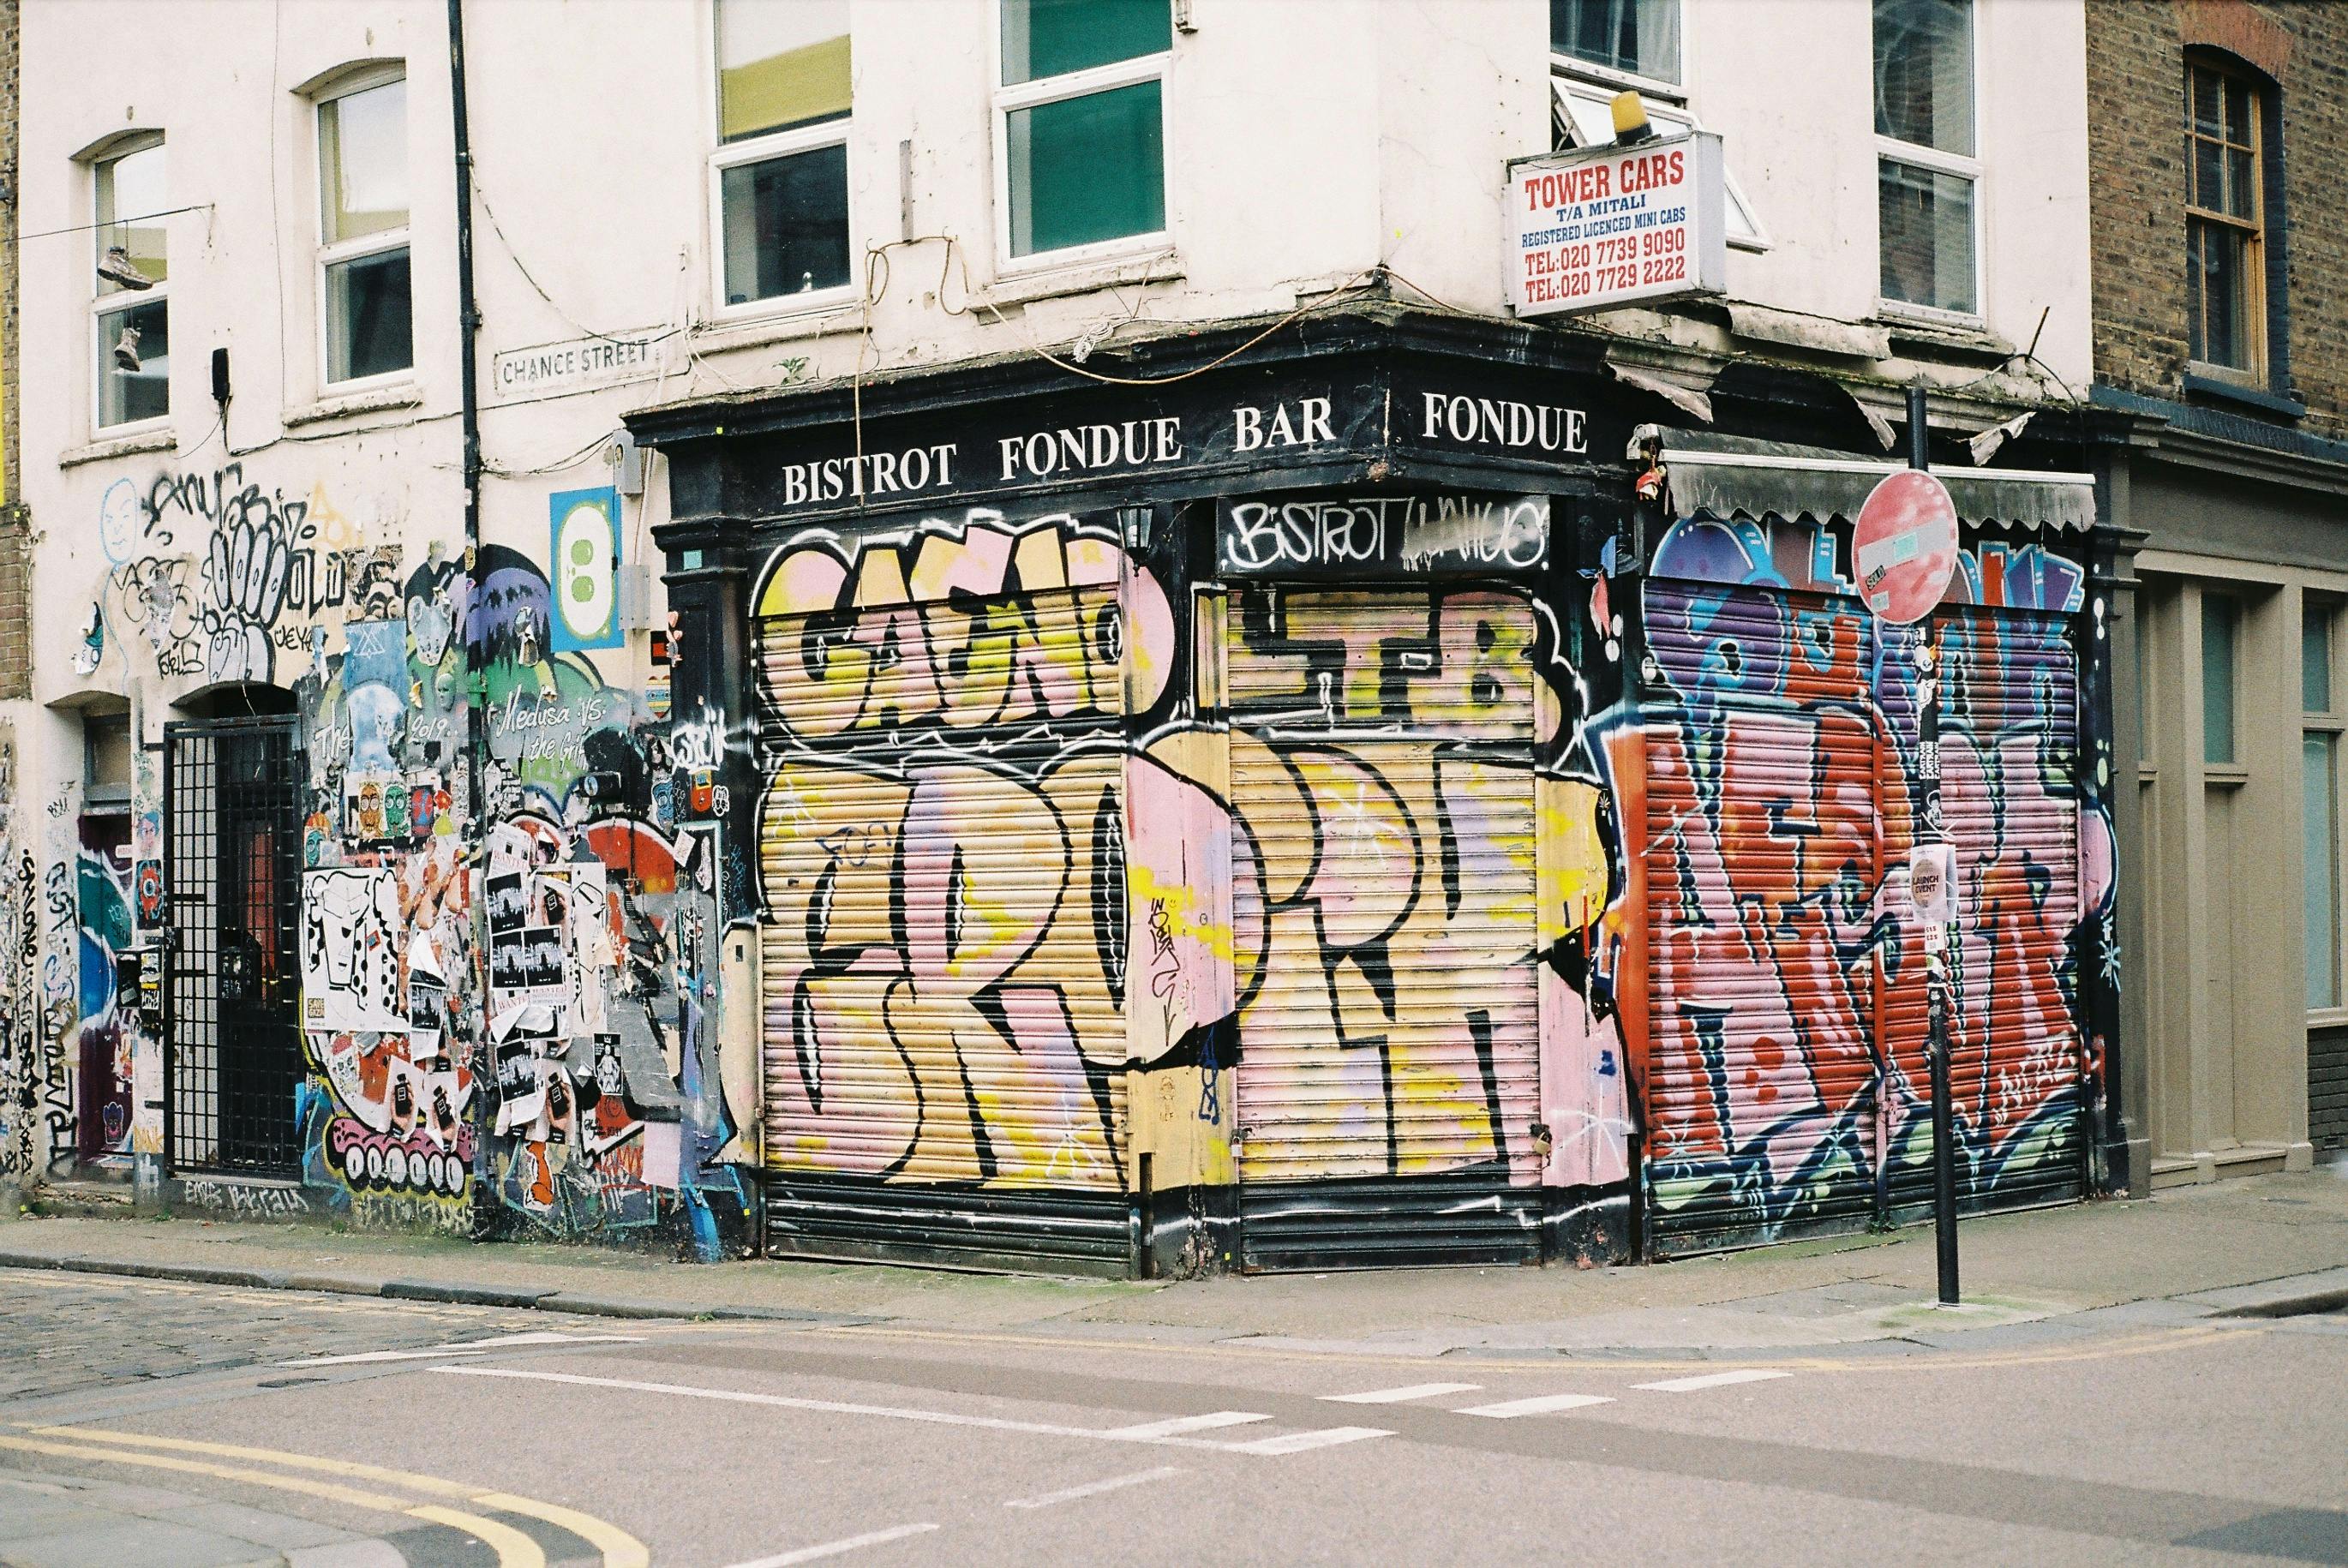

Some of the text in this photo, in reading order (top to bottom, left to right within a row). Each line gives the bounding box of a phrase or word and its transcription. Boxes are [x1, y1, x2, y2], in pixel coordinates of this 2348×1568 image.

[1525, 151, 1684, 211] TOWER CARS
[1522, 206, 1686, 248] REGISTERED LICENCED MINI CABS
[1556, 195, 1646, 222] T/A MITALI
[1525, 227, 1686, 276] TEL:020 7739 9090
[1525, 255, 1686, 303] TEL:020 7729 2222
[503, 351, 574, 384] CHANCE
[581, 338, 649, 371] STREET
[1422, 392, 1588, 454] FONDUE
[782, 397, 1337, 506] BISTROT FONDUE BAR
[497, 684, 570, 738] Medusa
[530, 733, 555, 760] the
[1912, 875, 1939, 886] LAUNCH
[1914, 884, 1937, 894] EVENT
